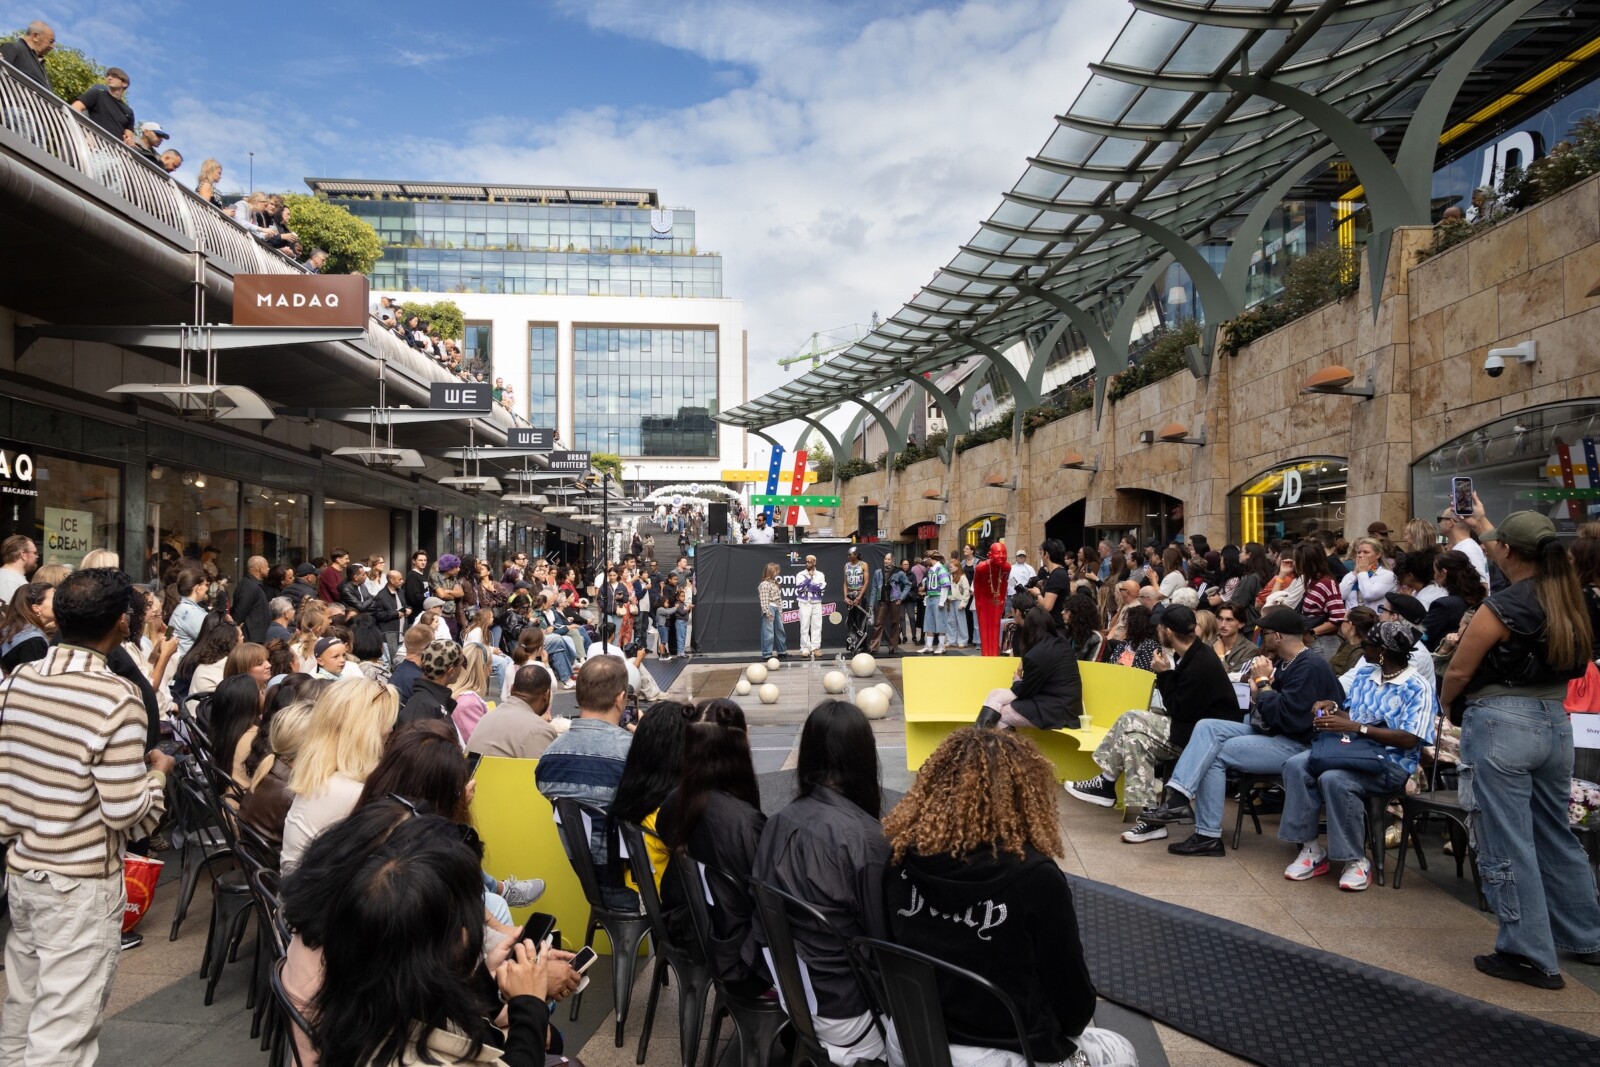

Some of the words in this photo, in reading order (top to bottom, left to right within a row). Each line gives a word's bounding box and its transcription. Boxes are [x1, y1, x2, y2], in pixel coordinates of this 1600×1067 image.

[257, 293, 339, 307] MADAQ
[445, 389, 477, 404] WE
[518, 433, 543, 444] WE
[567, 453, 588, 461] URBAN
[551, 461, 588, 469] OUTFITTERS
[2, 486, 38, 497] MACARONS
[1278, 469, 1302, 507] JD
[60, 517, 78, 532] ICE
[980, 518, 992, 538] JD
[48, 535, 88, 551] CREAM
[928, 573, 938, 590] 10
